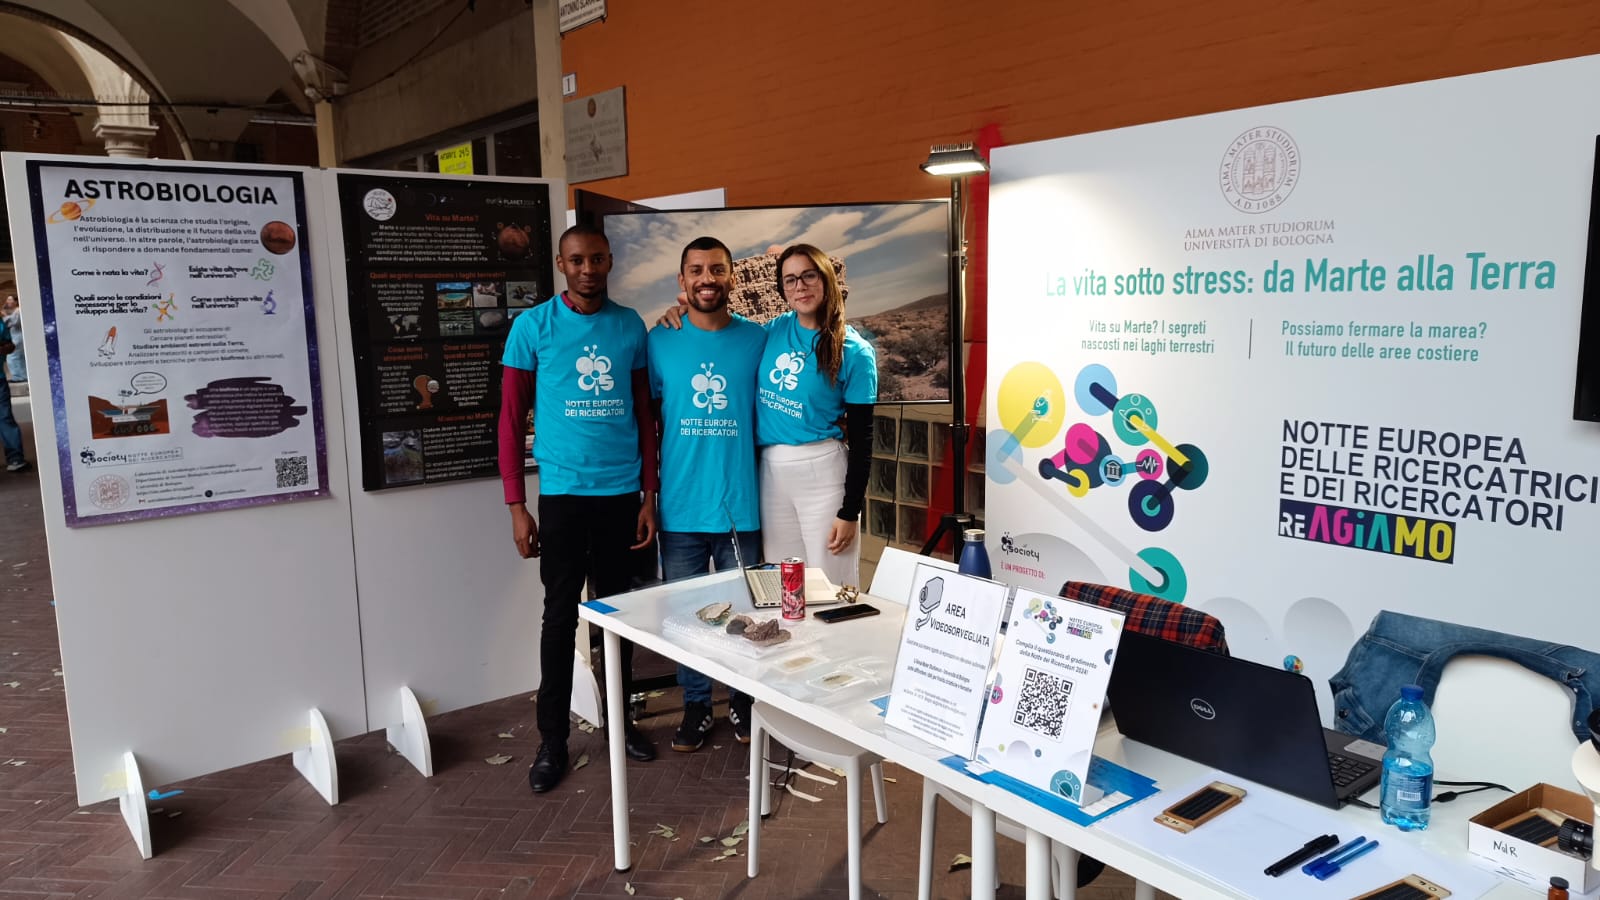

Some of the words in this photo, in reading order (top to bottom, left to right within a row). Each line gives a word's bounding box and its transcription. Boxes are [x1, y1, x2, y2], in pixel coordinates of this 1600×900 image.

[1223, 162, 1232, 192] ALMA
[1229, 130, 1261, 157] MATER
[1266, 130, 1298, 188] STUDIORUM
[64, 179, 278, 205] ASTROBIOLOGIA
[79, 215, 134, 226] Astrobiologia
[180, 217, 193, 225] che
[195, 217, 218, 226] studia
[1185, 228, 1214, 238] ALMA
[1218, 224, 1256, 236] MATER
[1260, 220, 1335, 234] STUDIORUM
[74, 226, 124, 235] l'evoluzione,
[135, 226, 185, 234] distribuzione
[200, 227, 222, 236] futuro
[224, 228, 241, 236] della
[242, 228, 256, 236] vita
[73, 236, 127, 244] nell'universo.
[137, 236, 156, 244] altre
[158, 237, 184, 246] parole,
[1184, 237, 1250, 252] UNIVERSITÀ
[1254, 238, 1268, 248] DI
[1272, 233, 1335, 247] BOLOGNA
[82, 246, 90, 254] di
[92, 246, 135, 255] rispondere
[143, 246, 178, 254] domande
[180, 246, 230, 254] fondamentali
[72, 269, 94, 277] Come
[122, 268, 129, 276] la
[130, 268, 148, 276] vita?
[1046, 271, 1066, 296] La
[1072, 268, 1106, 296] vita
[1114, 267, 1164, 296] sotto
[1172, 266, 1254, 295] stress:
[1264, 260, 1294, 293] da
[1305, 258, 1386, 292] Marte
[1397, 254, 1454, 292] alla
[1466, 252, 1556, 290] Terra
[74, 294, 96, 303] Quali
[125, 293, 162, 301] condizioni
[116, 302, 129, 310] per
[76, 308, 108, 316] sviluppo
[130, 306, 148, 314] vita?
[1089, 320, 1106, 334] Vita
[1109, 324, 1120, 334] su
[1124, 320, 1158, 335] Marte?
[1168, 320, 1207, 338] segreti
[1282, 320, 1344, 336] Possiamo
[1348, 320, 1404, 337] fermare
[1410, 322, 1422, 338] la
[1428, 322, 1488, 340] marea?
[1081, 338, 1120, 351] nascosti
[1123, 338, 1138, 352] nei
[1141, 338, 1166, 356] laghi
[1170, 339, 1215, 354] terrestri
[1286, 341, 1294, 356] Il
[1298, 341, 1336, 357] futuro
[1342, 342, 1374, 358] delle
[1379, 346, 1412, 359] aree
[1417, 344, 1479, 362] costiere
[565, 408, 578, 417] DEI
[579, 408, 624, 417] RICERCATORI
[566, 400, 590, 408] NOTTE
[592, 399, 624, 408] EUROPEA
[681, 418, 702, 427] NOTTE
[704, 419, 738, 428] EUROPEA
[680, 428, 690, 436] DEI
[692, 428, 738, 438] RICERCATORI
[1282, 419, 1368, 450] NOTTE
[1378, 426, 1526, 464] EUROPEA
[1281, 446, 1364, 476] DELLE
[1374, 455, 1598, 504] RICERCATRICI
[1280, 472, 1295, 496] E
[1303, 474, 1344, 502] DEI
[1354, 480, 1564, 532] RICERCATORI
[1004, 563, 1011, 571] UN
[1012, 564, 1038, 578] PROGETTO
[945, 602, 966, 620] AREA
[930, 618, 990, 647] VIDEOSORVEGLIATA
[1016, 640, 1034, 650] Compila
[1038, 645, 1064, 660] questionario
[1070, 657, 1097, 669] gradimento
[1031, 652, 1042, 660] Notte
[1050, 658, 1075, 670] Ricercatori
